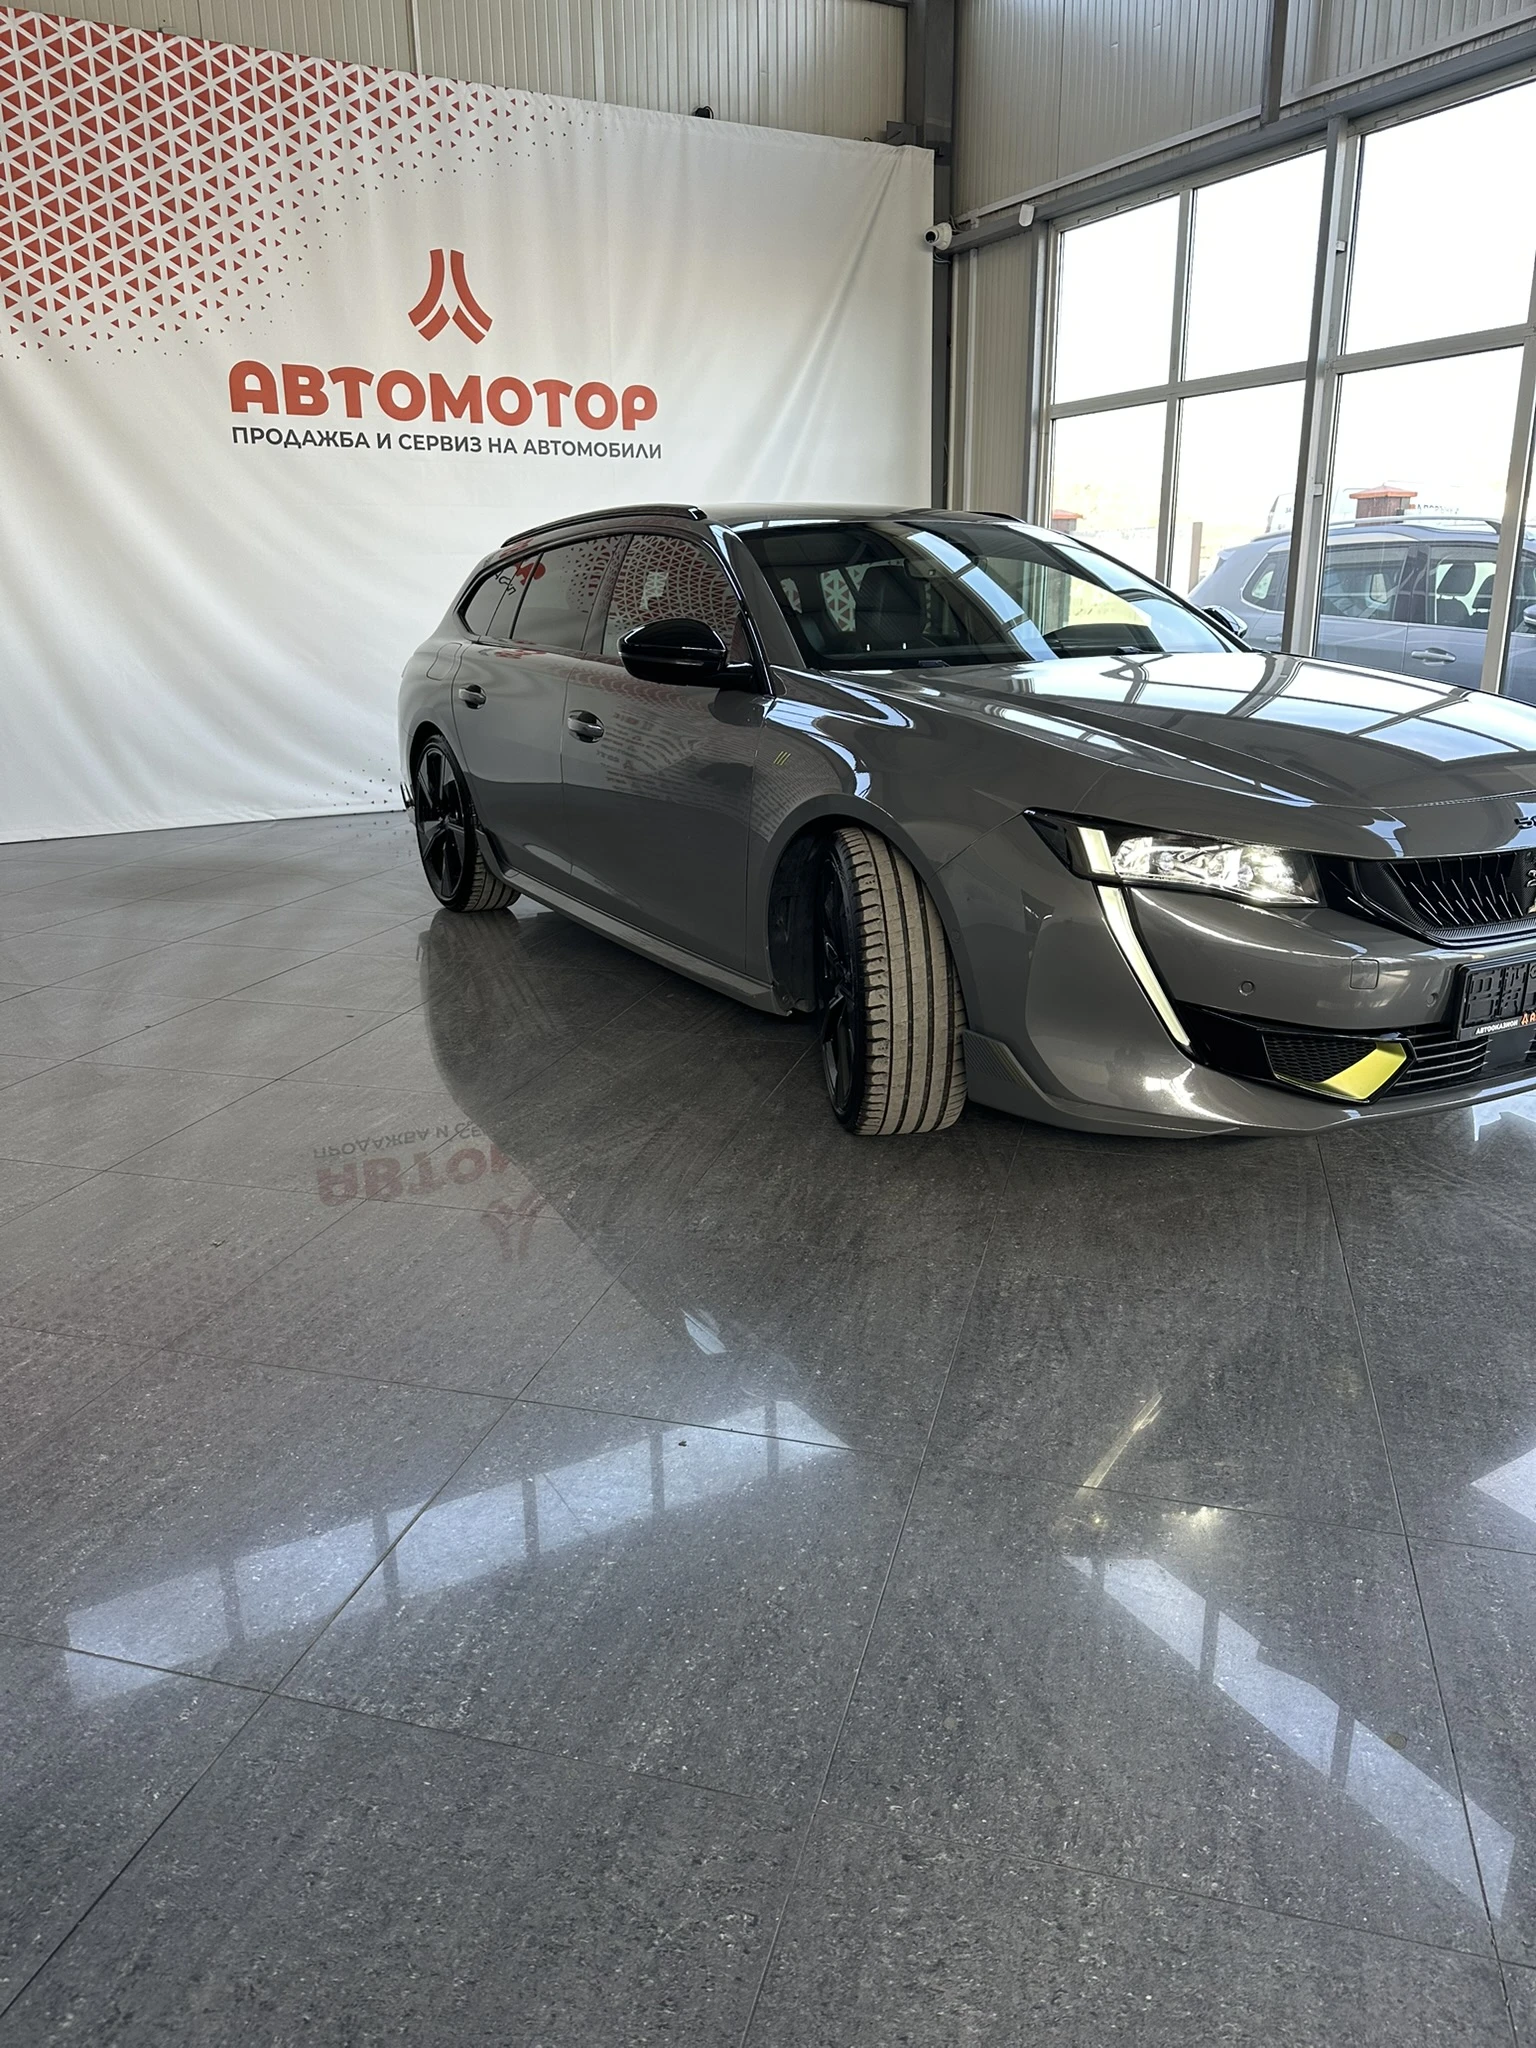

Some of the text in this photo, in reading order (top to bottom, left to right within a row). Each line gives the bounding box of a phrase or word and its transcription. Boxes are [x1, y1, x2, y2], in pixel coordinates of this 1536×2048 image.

[229, 360, 658, 431] АВТОМОТОР
[232, 427, 662, 459] ПРОДАЖБА И СЕРВИЗ НА АВТОМОБИЛИ
